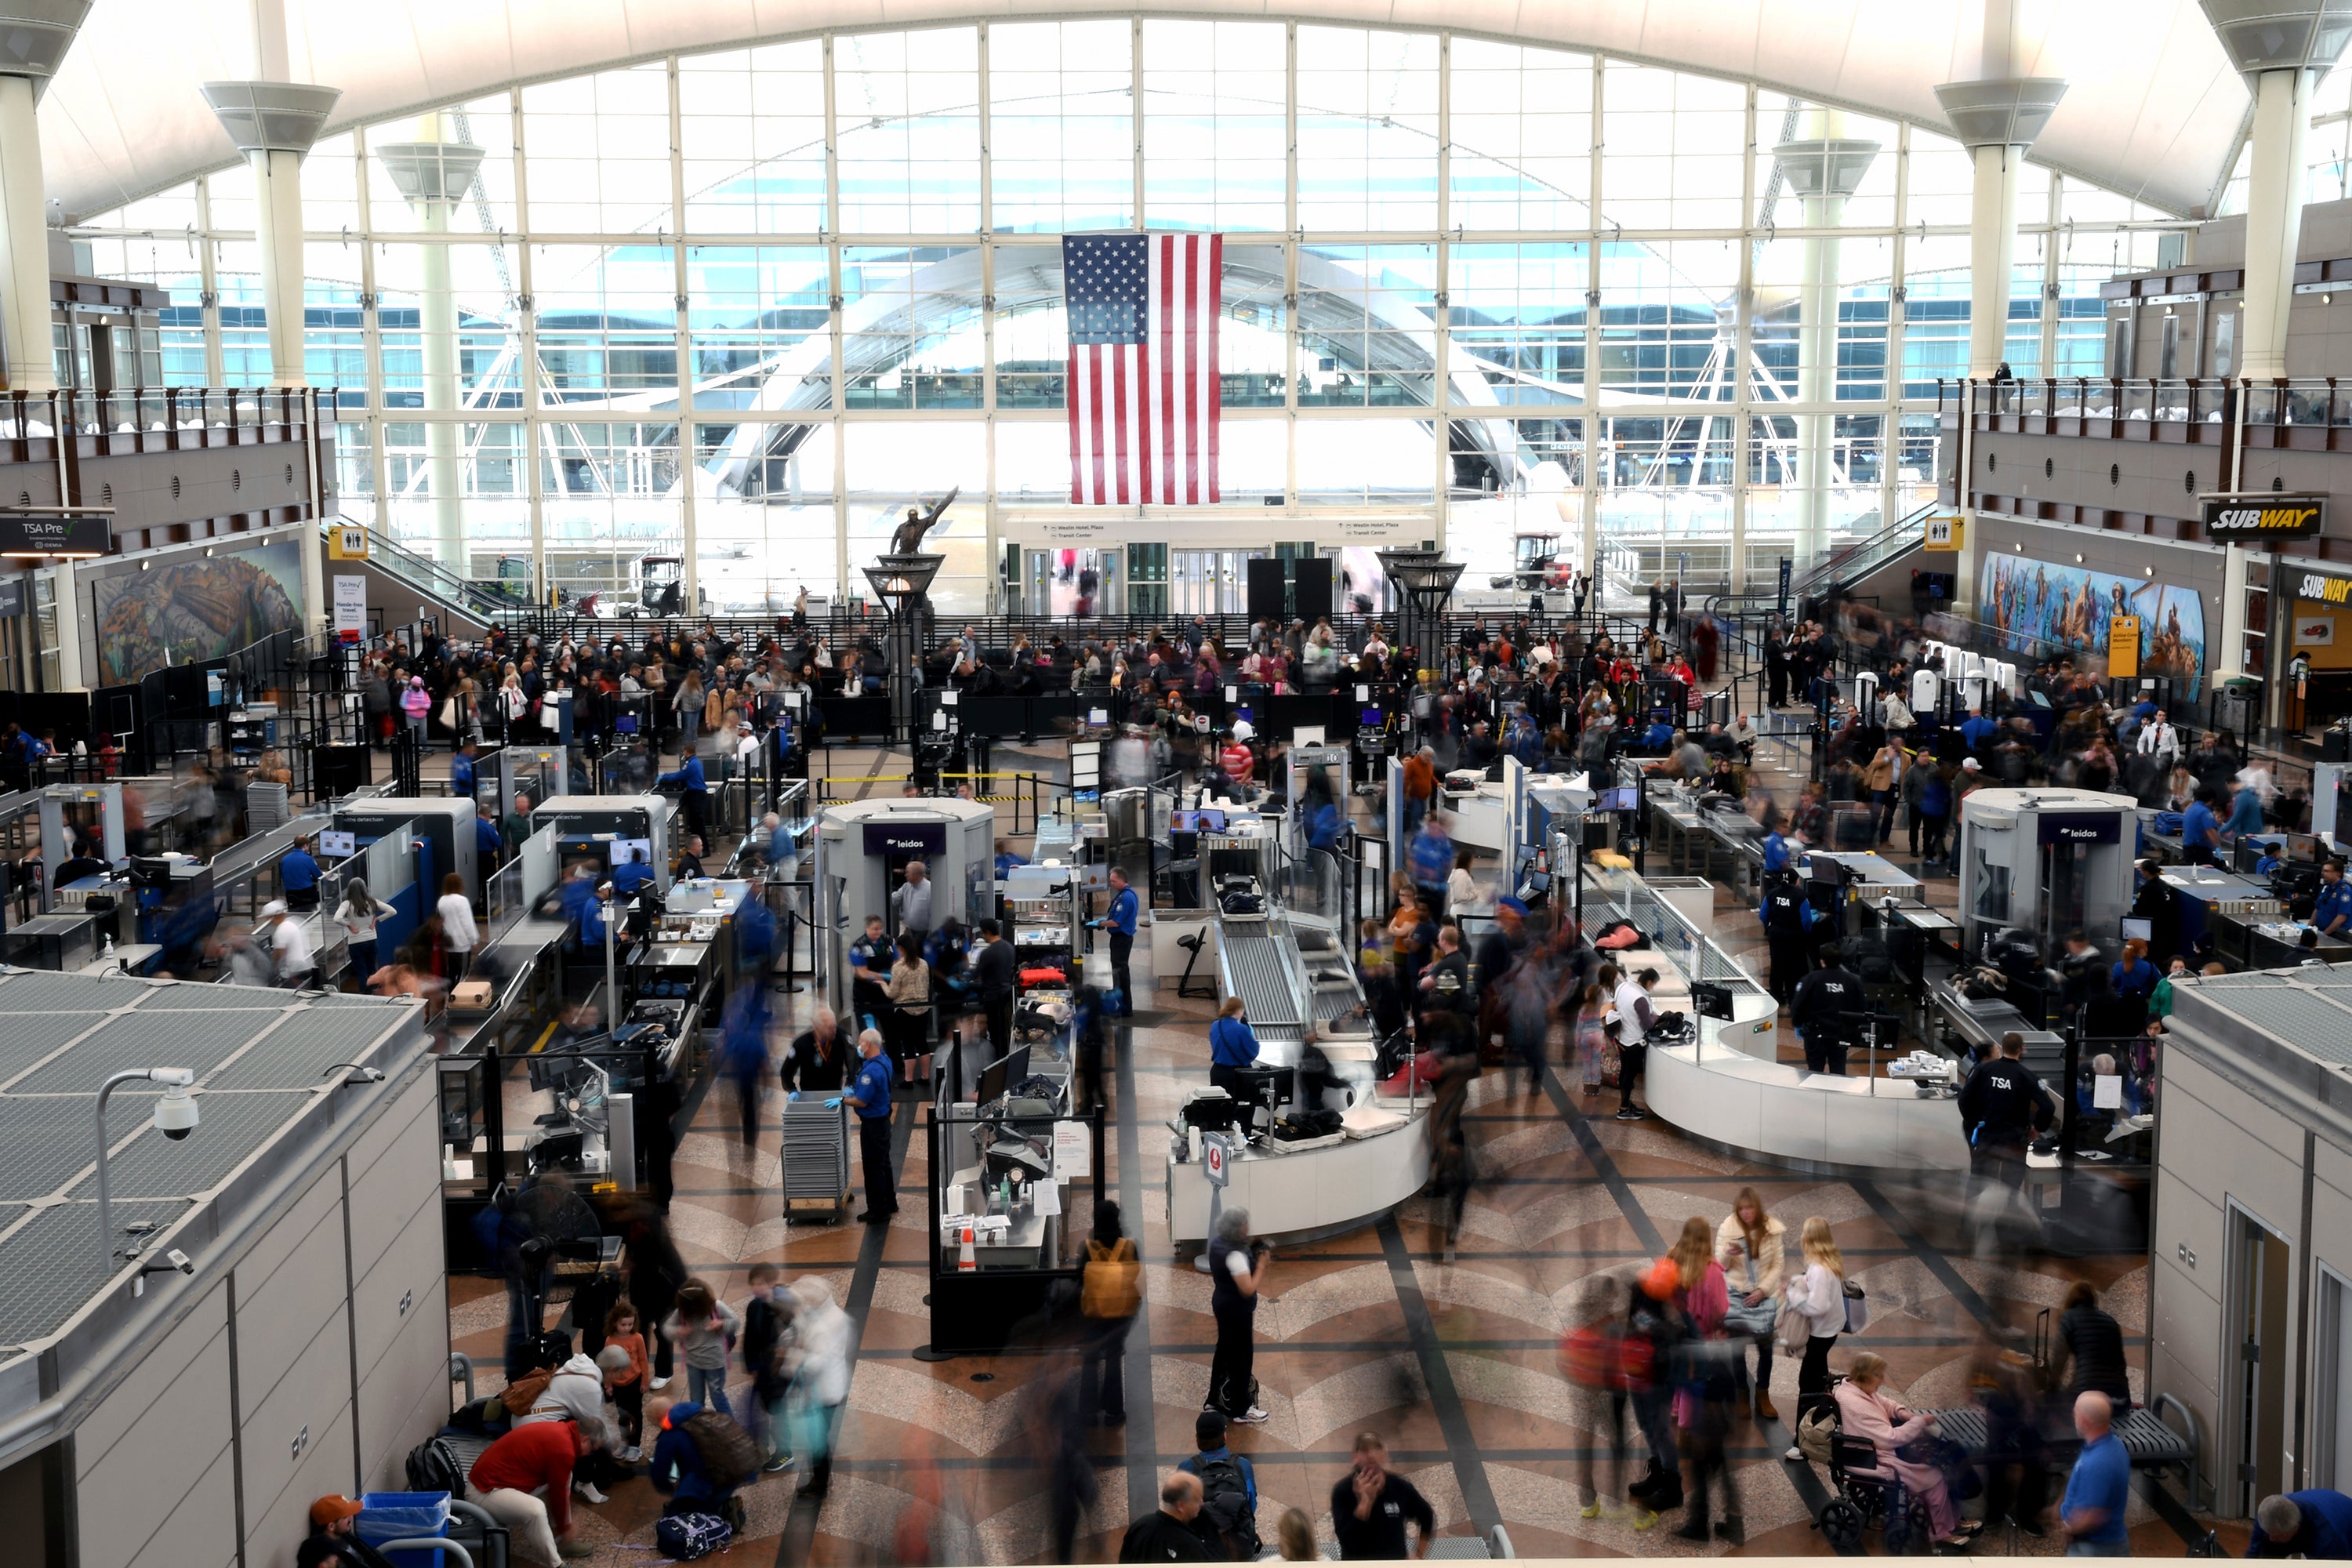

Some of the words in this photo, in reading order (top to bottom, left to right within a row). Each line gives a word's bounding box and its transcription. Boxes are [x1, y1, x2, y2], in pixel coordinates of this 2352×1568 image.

[2211, 508, 2318, 529] SUBWAY
[23, 524, 43, 533] TSA
[45, 524, 63, 533] Pre
[2299, 574, 2352, 603] SUBWAY
[1776, 897, 1790, 906] TSA
[1825, 983, 1844, 993] TSA
[1991, 1076, 2011, 1090] TSA
